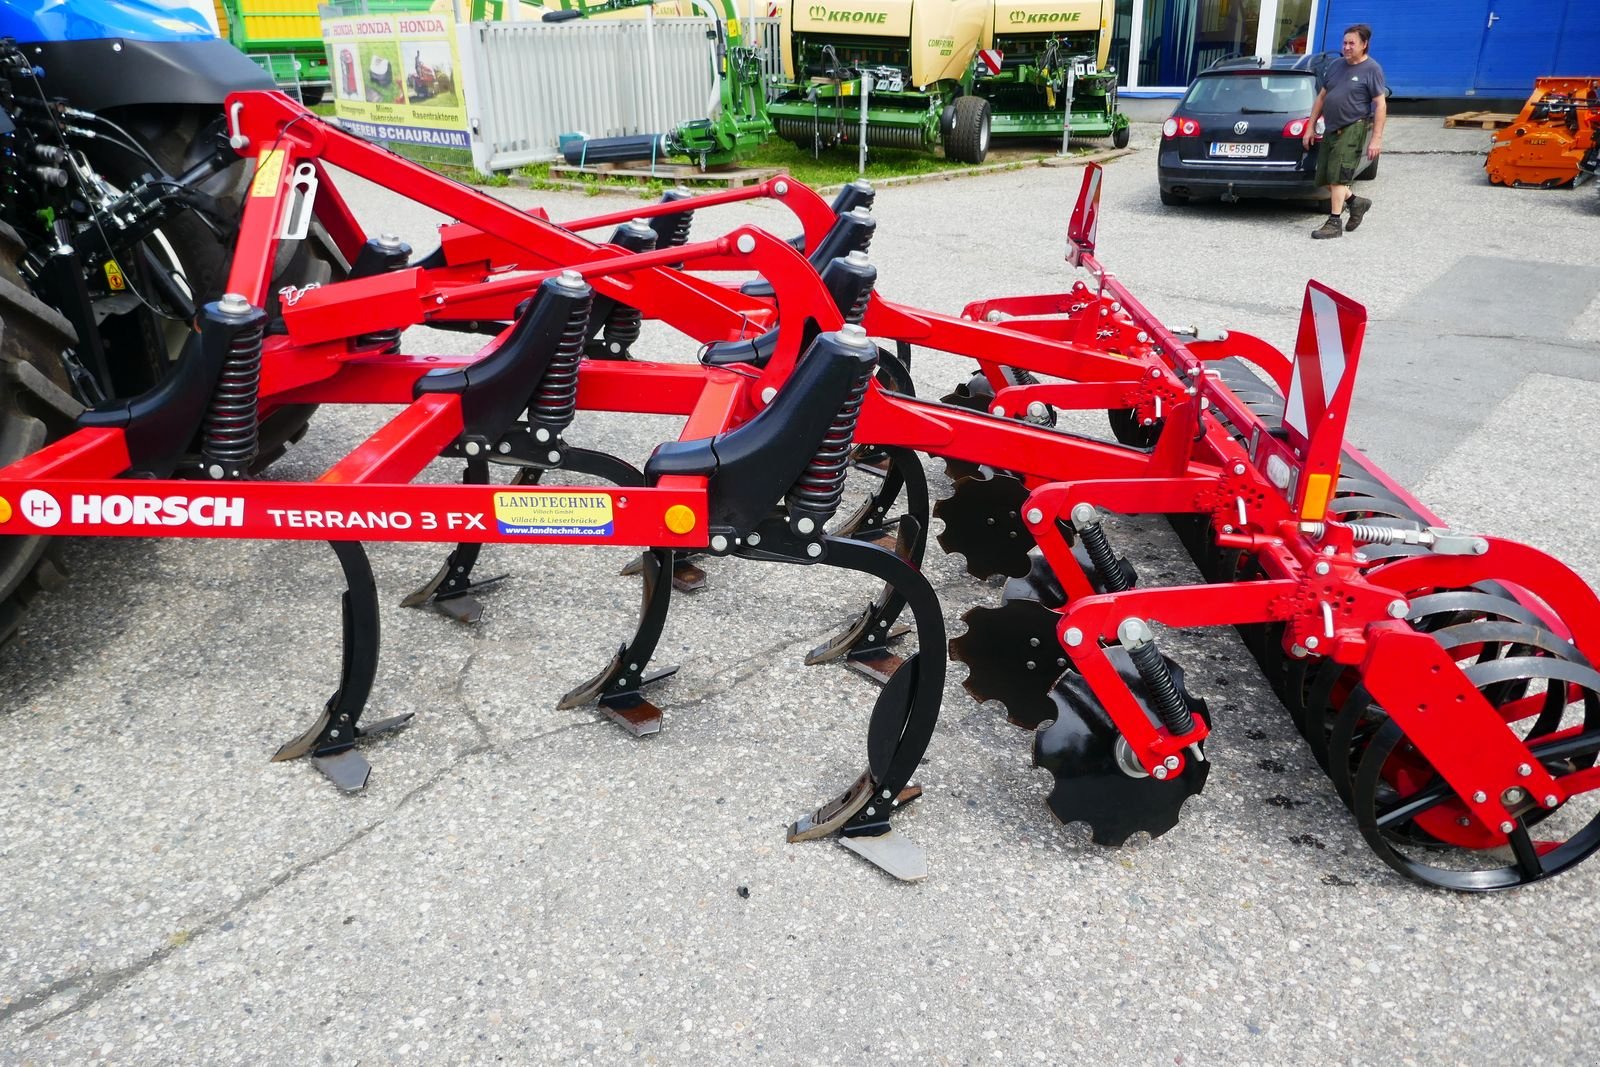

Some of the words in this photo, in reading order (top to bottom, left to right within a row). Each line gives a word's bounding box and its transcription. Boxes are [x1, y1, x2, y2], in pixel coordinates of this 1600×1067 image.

[828, 11, 888, 24] KRONE
[1026, 12, 1081, 24] KRONE
[333, 24, 354, 36] HONDA
[356, 22, 392, 34] HONDA
[400, 20, 444, 33] HONDA
[412, 110, 459, 122] Rasentraktoren
[378, 126, 466, 146] SCHAURAUM!
[1218, 144, 1228, 153] KL
[1235, 145, 1252, 154] 599
[1253, 145, 1265, 154] DE
[499, 496, 606, 509] LANDTECHNIK
[71, 494, 245, 527] HORSCH
[267, 509, 412, 530] TERRANO
[420, 511, 438, 530] 3
[447, 512, 487, 531] FX
[505, 527, 605, 536] www.landtechnik.co.at
